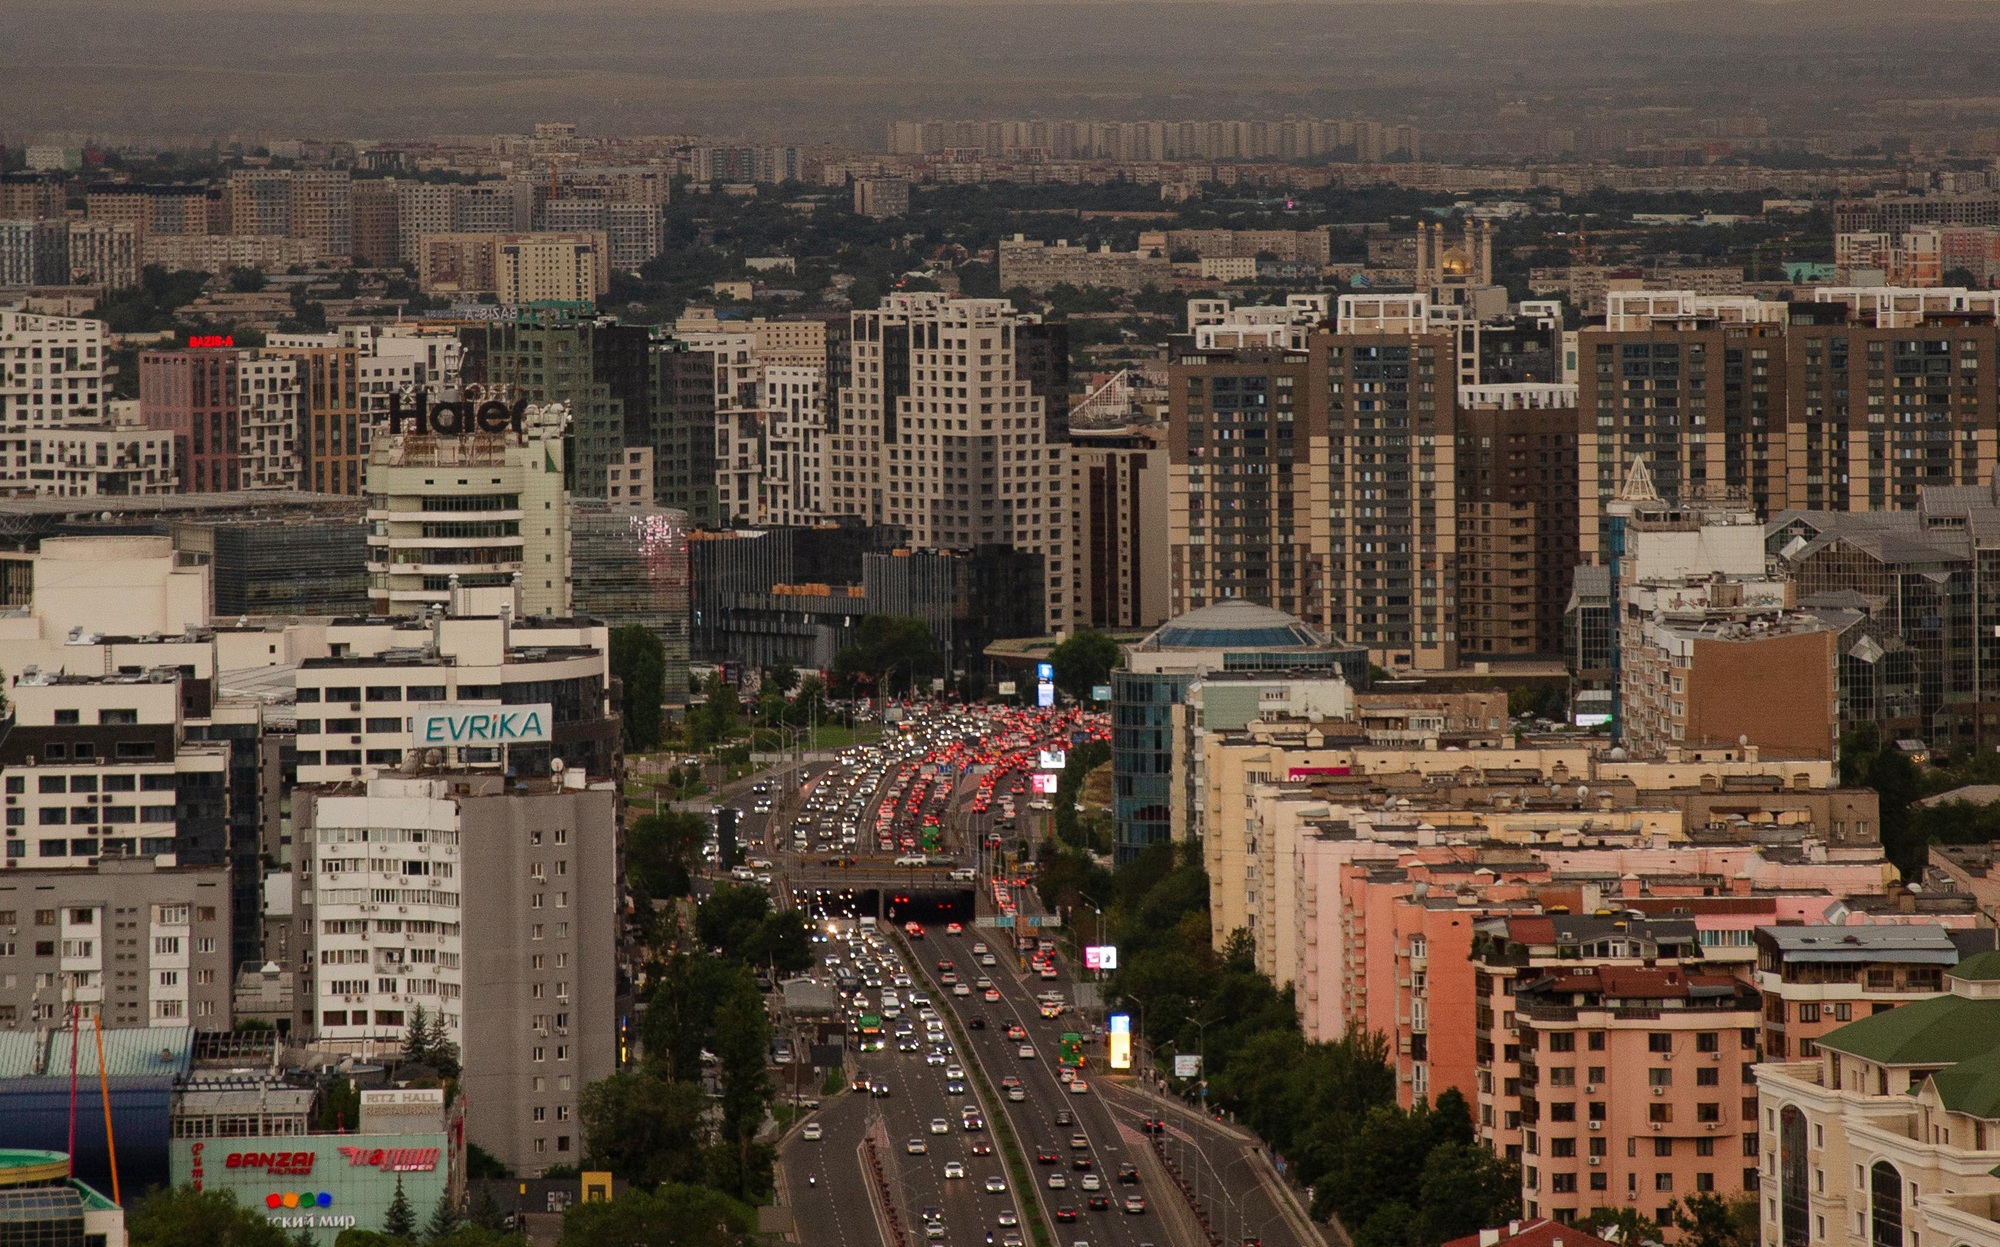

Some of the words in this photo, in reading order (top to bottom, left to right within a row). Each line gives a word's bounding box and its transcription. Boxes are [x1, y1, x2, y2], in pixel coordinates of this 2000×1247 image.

[189, 335, 233, 348] BAZIS-A
[389, 391, 527, 434] Haier
[366, 1093, 396, 1103] RITZ
[402, 1092, 438, 1102] HALL
[225, 1151, 316, 1169] BANZAI
[319, 1215, 356, 1230] мир
